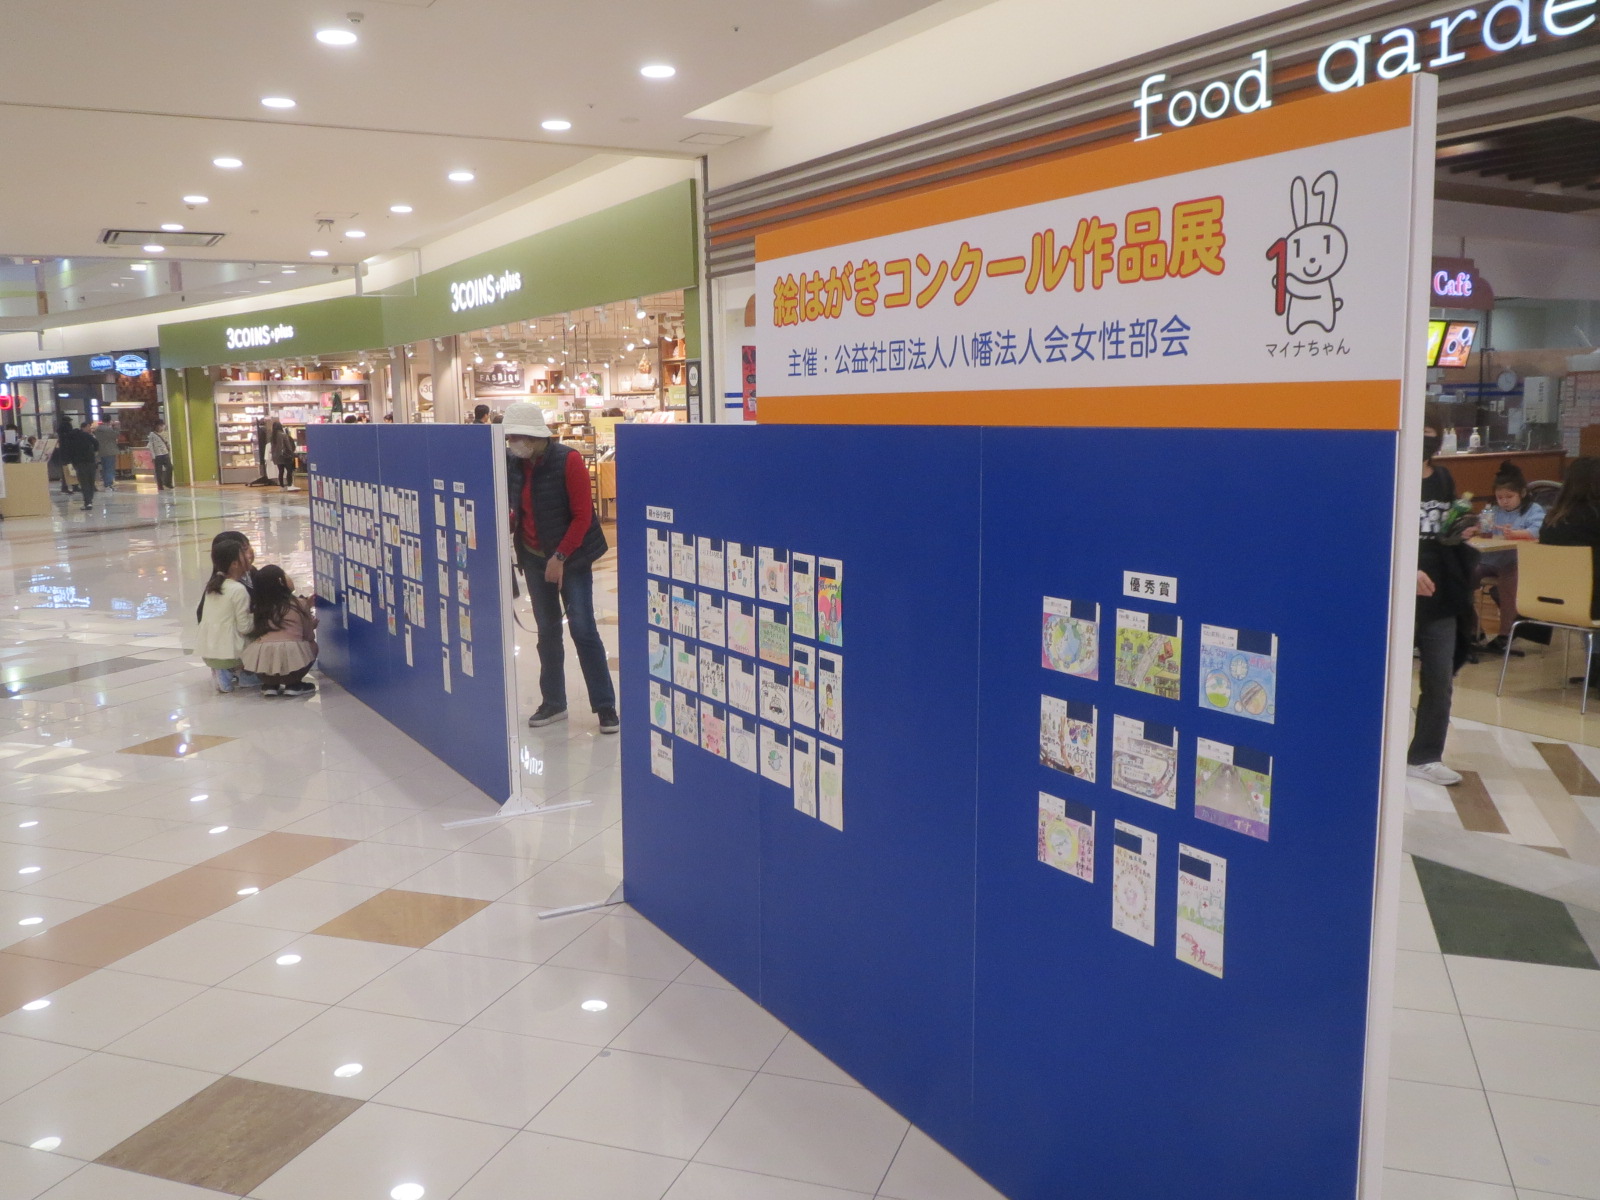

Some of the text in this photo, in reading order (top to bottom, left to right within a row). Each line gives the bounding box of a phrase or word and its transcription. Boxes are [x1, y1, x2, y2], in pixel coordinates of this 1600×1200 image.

[1133, 49, 1273, 142] food
[773, 194, 1227, 327] 絵はがきコンクール作品展
[1433, 270, 1473, 296] Café
[1265, 338, 1351, 358] マイナちゃん
[1129, 576, 1171, 598] 優秀賞
